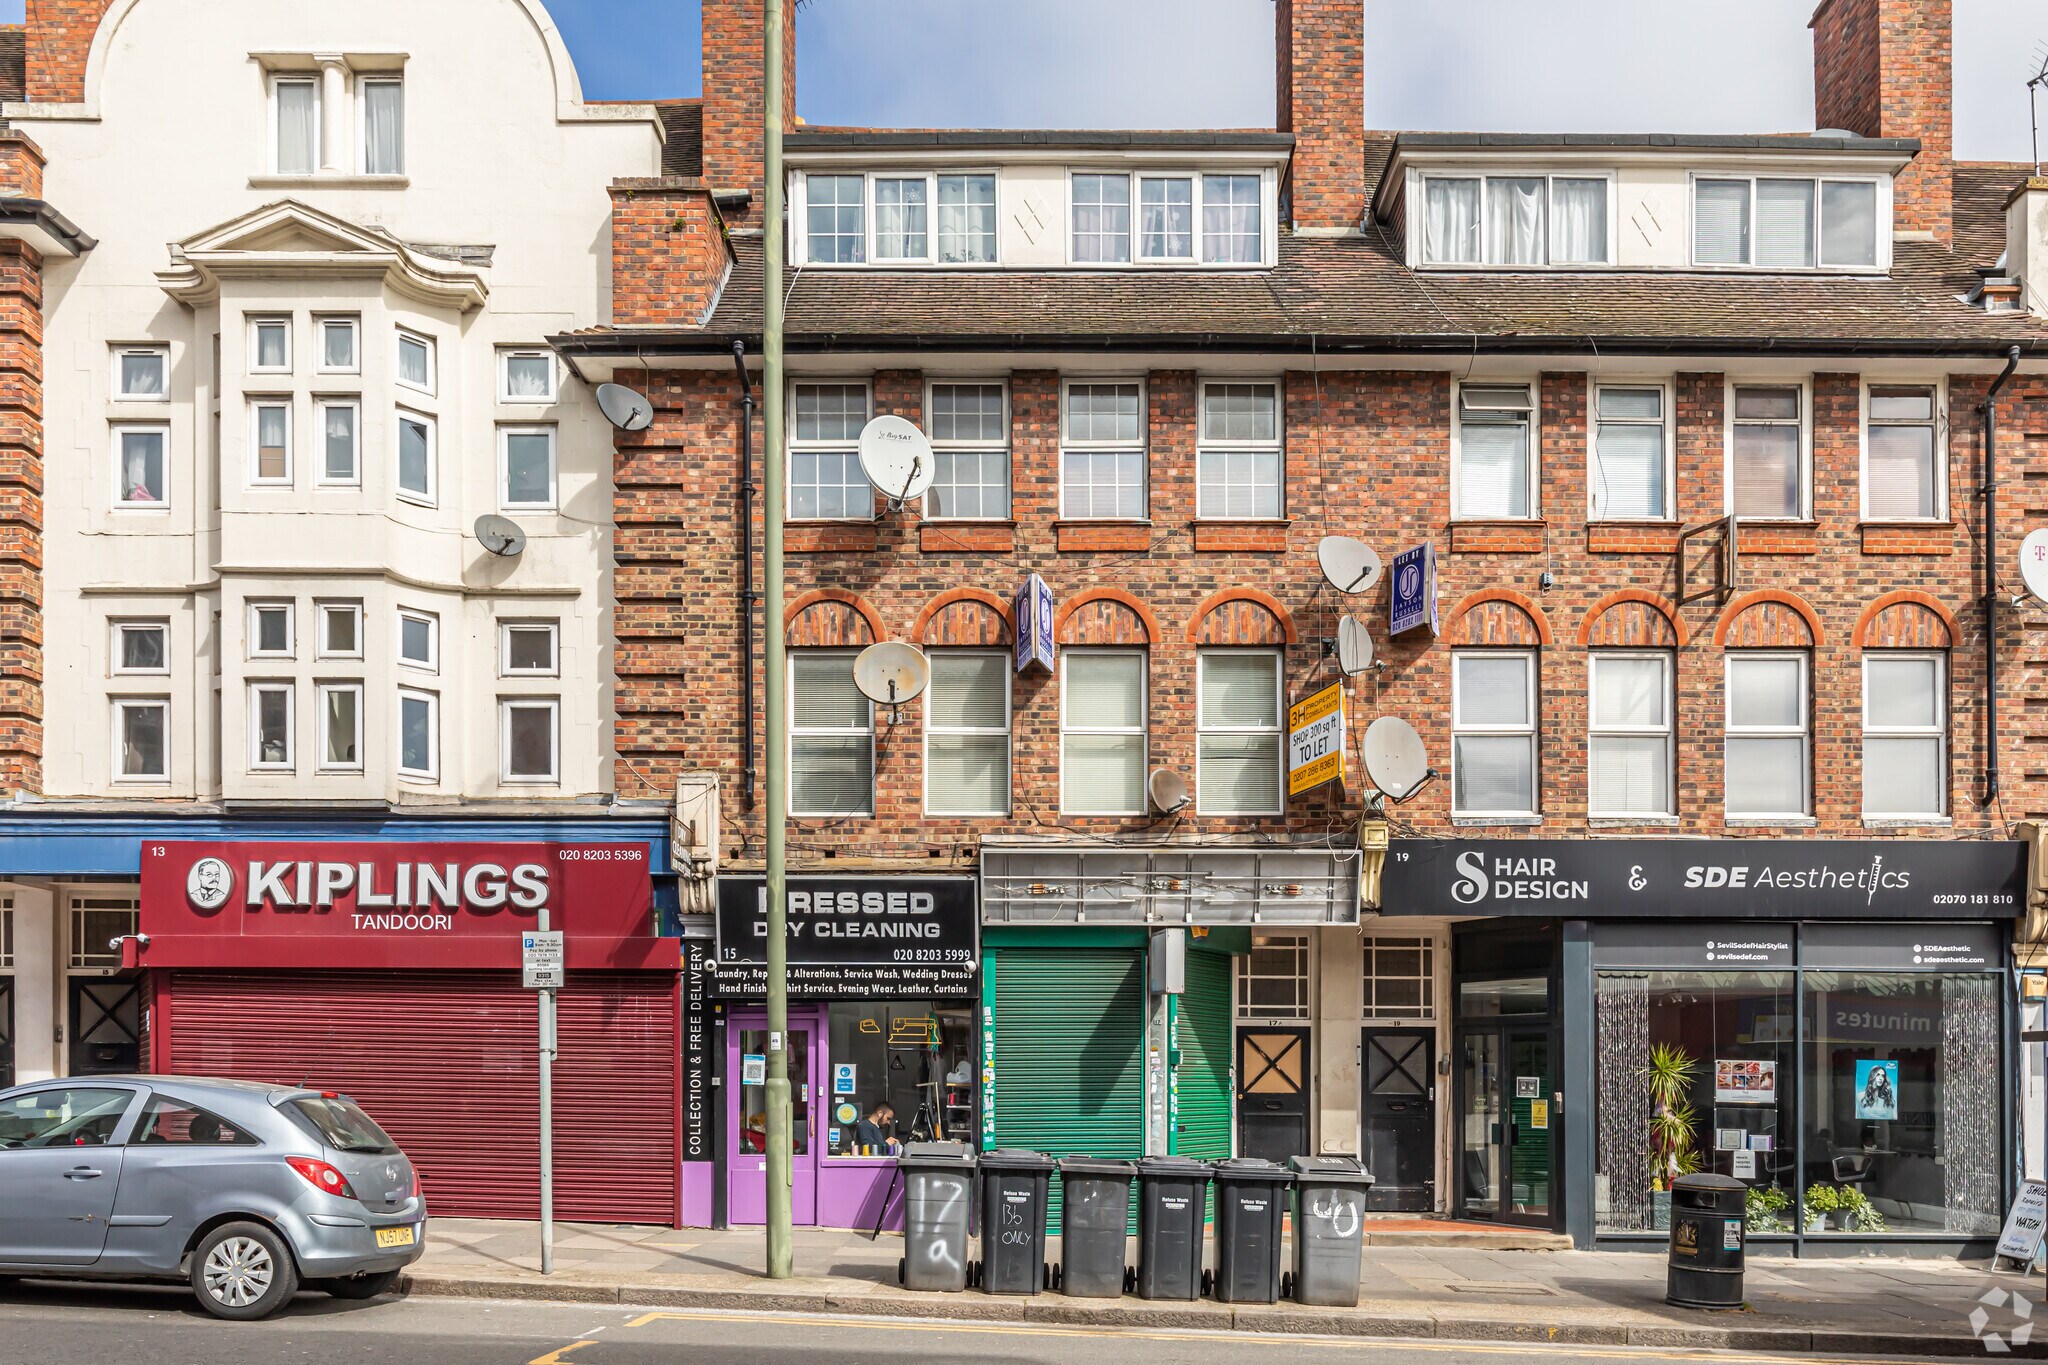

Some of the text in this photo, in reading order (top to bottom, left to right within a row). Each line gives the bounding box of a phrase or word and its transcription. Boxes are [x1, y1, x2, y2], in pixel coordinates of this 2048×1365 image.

[1398, 550, 1419, 565] LET BY
[1395, 595, 1422, 612] JAYSON
[1395, 603, 1422, 618] RUSSELL
[1306, 690, 1338, 711] PROPERTY
[1291, 705, 1306, 727] 3H
[1306, 699, 1338, 720] CONSULTANTS
[1293, 715, 1336, 747] SHOP 300 sq ft
[1300, 736, 1329, 763] TO LET
[1293, 769, 1306, 783] 0207
[151, 846, 165, 857] 13
[560, 850, 642, 860] 020 8203 5396
[1396, 853, 1409, 861] 19
[1495, 858, 1556, 876] HAIR
[246, 861, 550, 908] KIPLINGS
[1451, 851, 1489, 904] S
[1628, 865, 1647, 891] &
[1684, 866, 1749, 888] SDE
[1495, 881, 1588, 898] DESIGN
[1933, 895, 2013, 904] 02070 181 810
[350, 914, 452, 930] TANDOORI
[753, 921, 940, 937] DY CLEANING
[723, 948, 736, 959] 15
[1717, 942, 1788, 950] SevilSedefHairStylist
[893, 949, 971, 960] 020 8203 5999
[714, 969, 750, 980] Laundry,
[794, 969, 841, 978] Alterations,
[844, 969, 873, 978] Service
[875, 970, 900, 979] Wash,
[902, 969, 939, 980] Wedding
[941, 970, 972, 978] Dresses
[719, 983, 740, 993] Hand
[786, 983, 968, 995] hirt Service, Evening Wear, Leather, Curtains
[690, 944, 702, 1155] COLLECTION & FREE DELIVERY
[2016, 1216, 2041, 1230] WATCH
[379, 1230, 397, 1244] NJ57
[1002, 1231, 1031, 1247] ONLY
